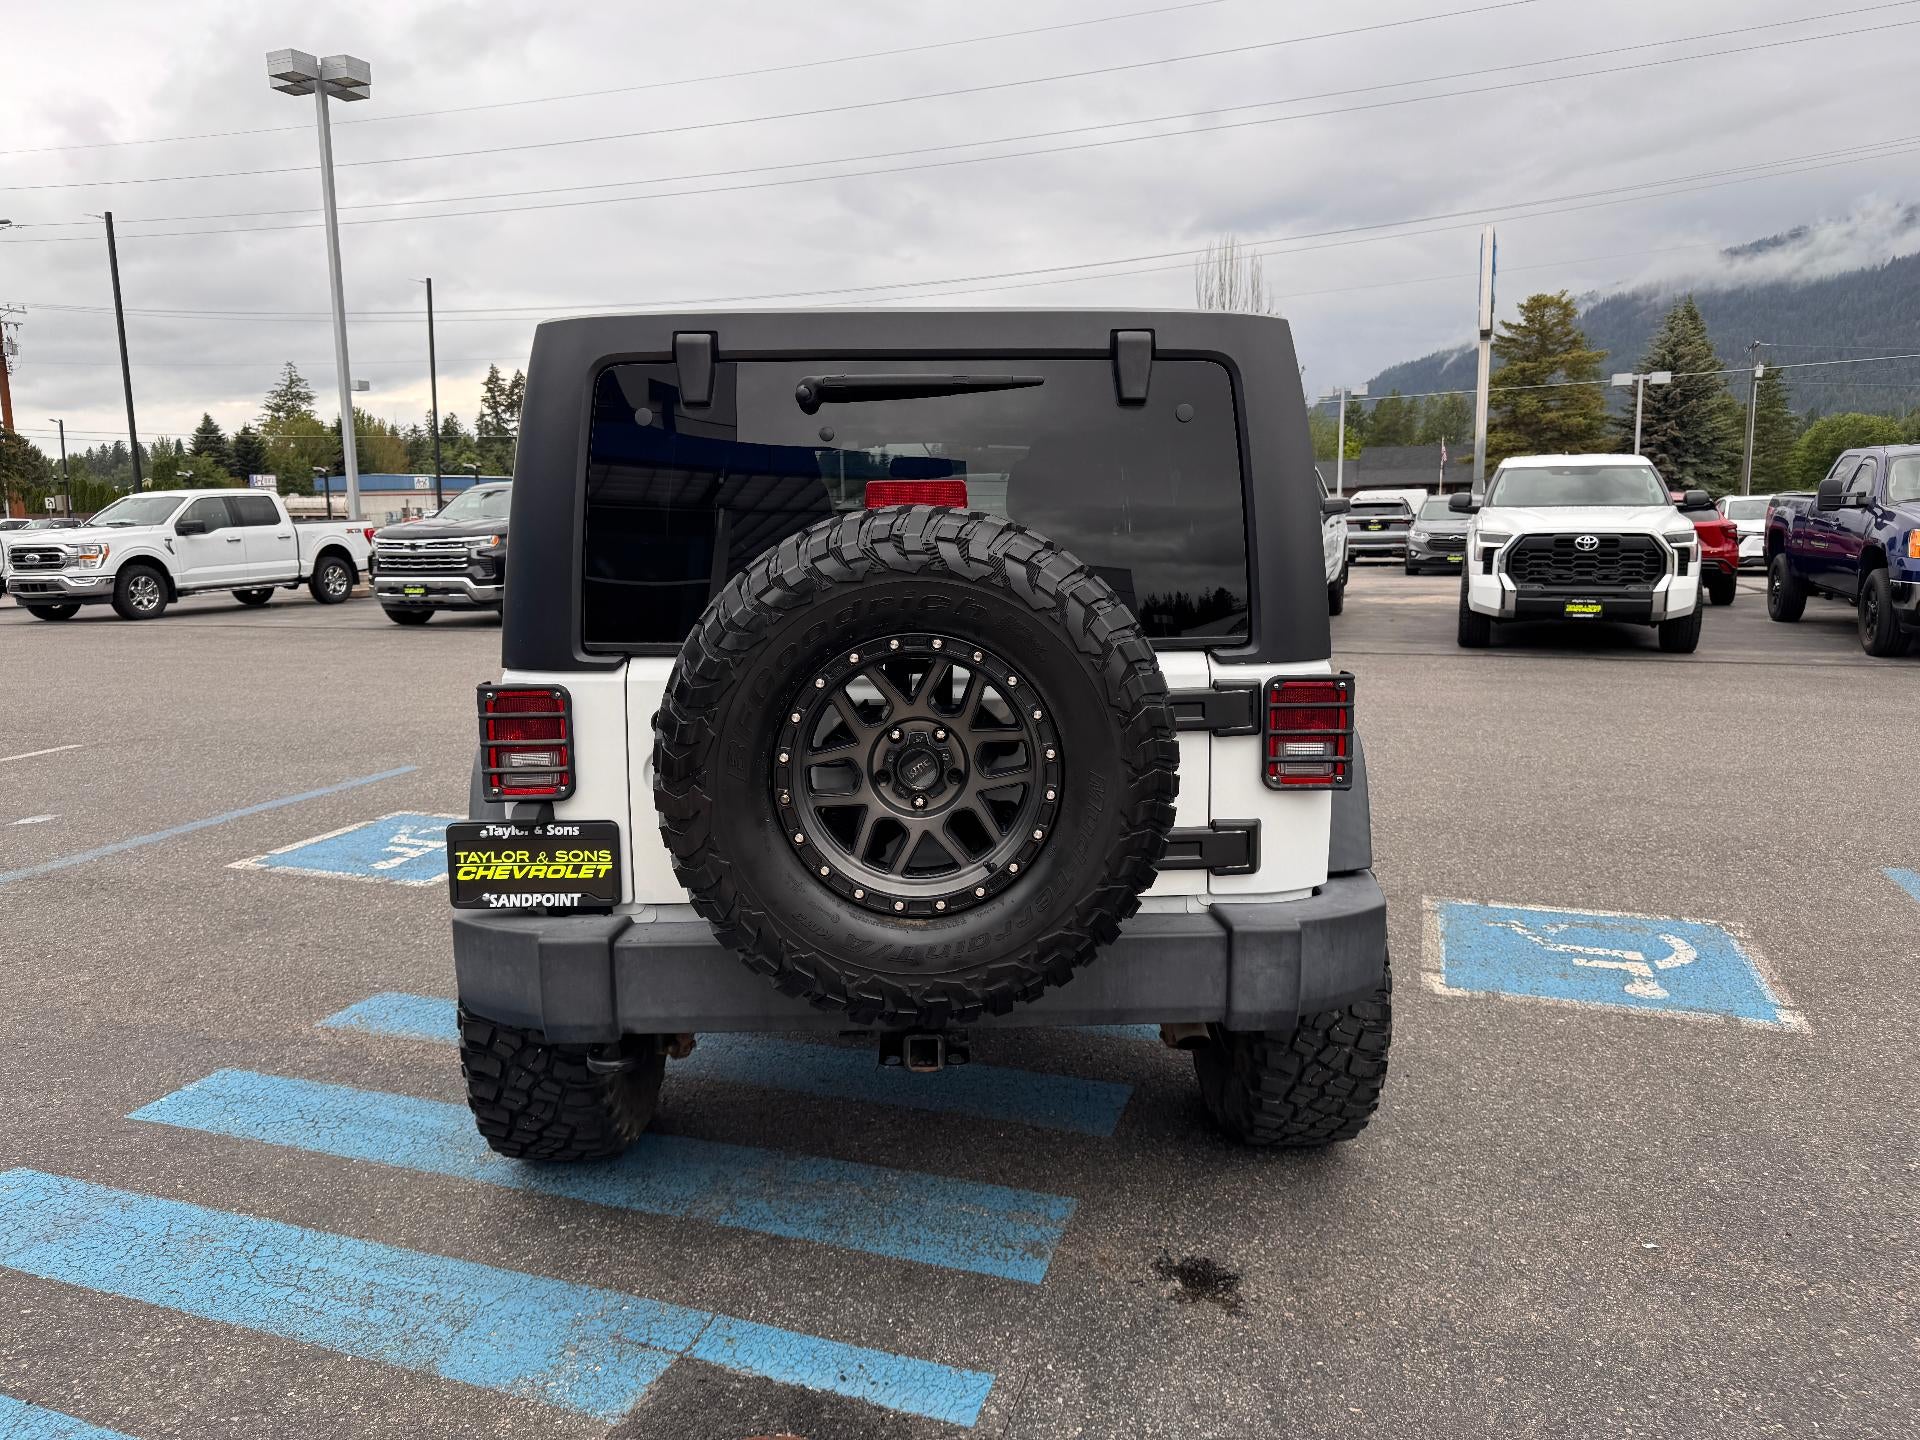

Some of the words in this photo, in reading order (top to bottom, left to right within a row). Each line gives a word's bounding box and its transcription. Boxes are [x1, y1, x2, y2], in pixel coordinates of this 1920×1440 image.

[534, 826, 543, 835] &
[546, 824, 580, 836] Sons
[455, 851, 529, 864] TAYLOR
[536, 852, 549, 864] &
[555, 850, 612, 863] SONS
[456, 864, 613, 881] CHEVROLET
[489, 893, 582, 908] SANDPOINT
